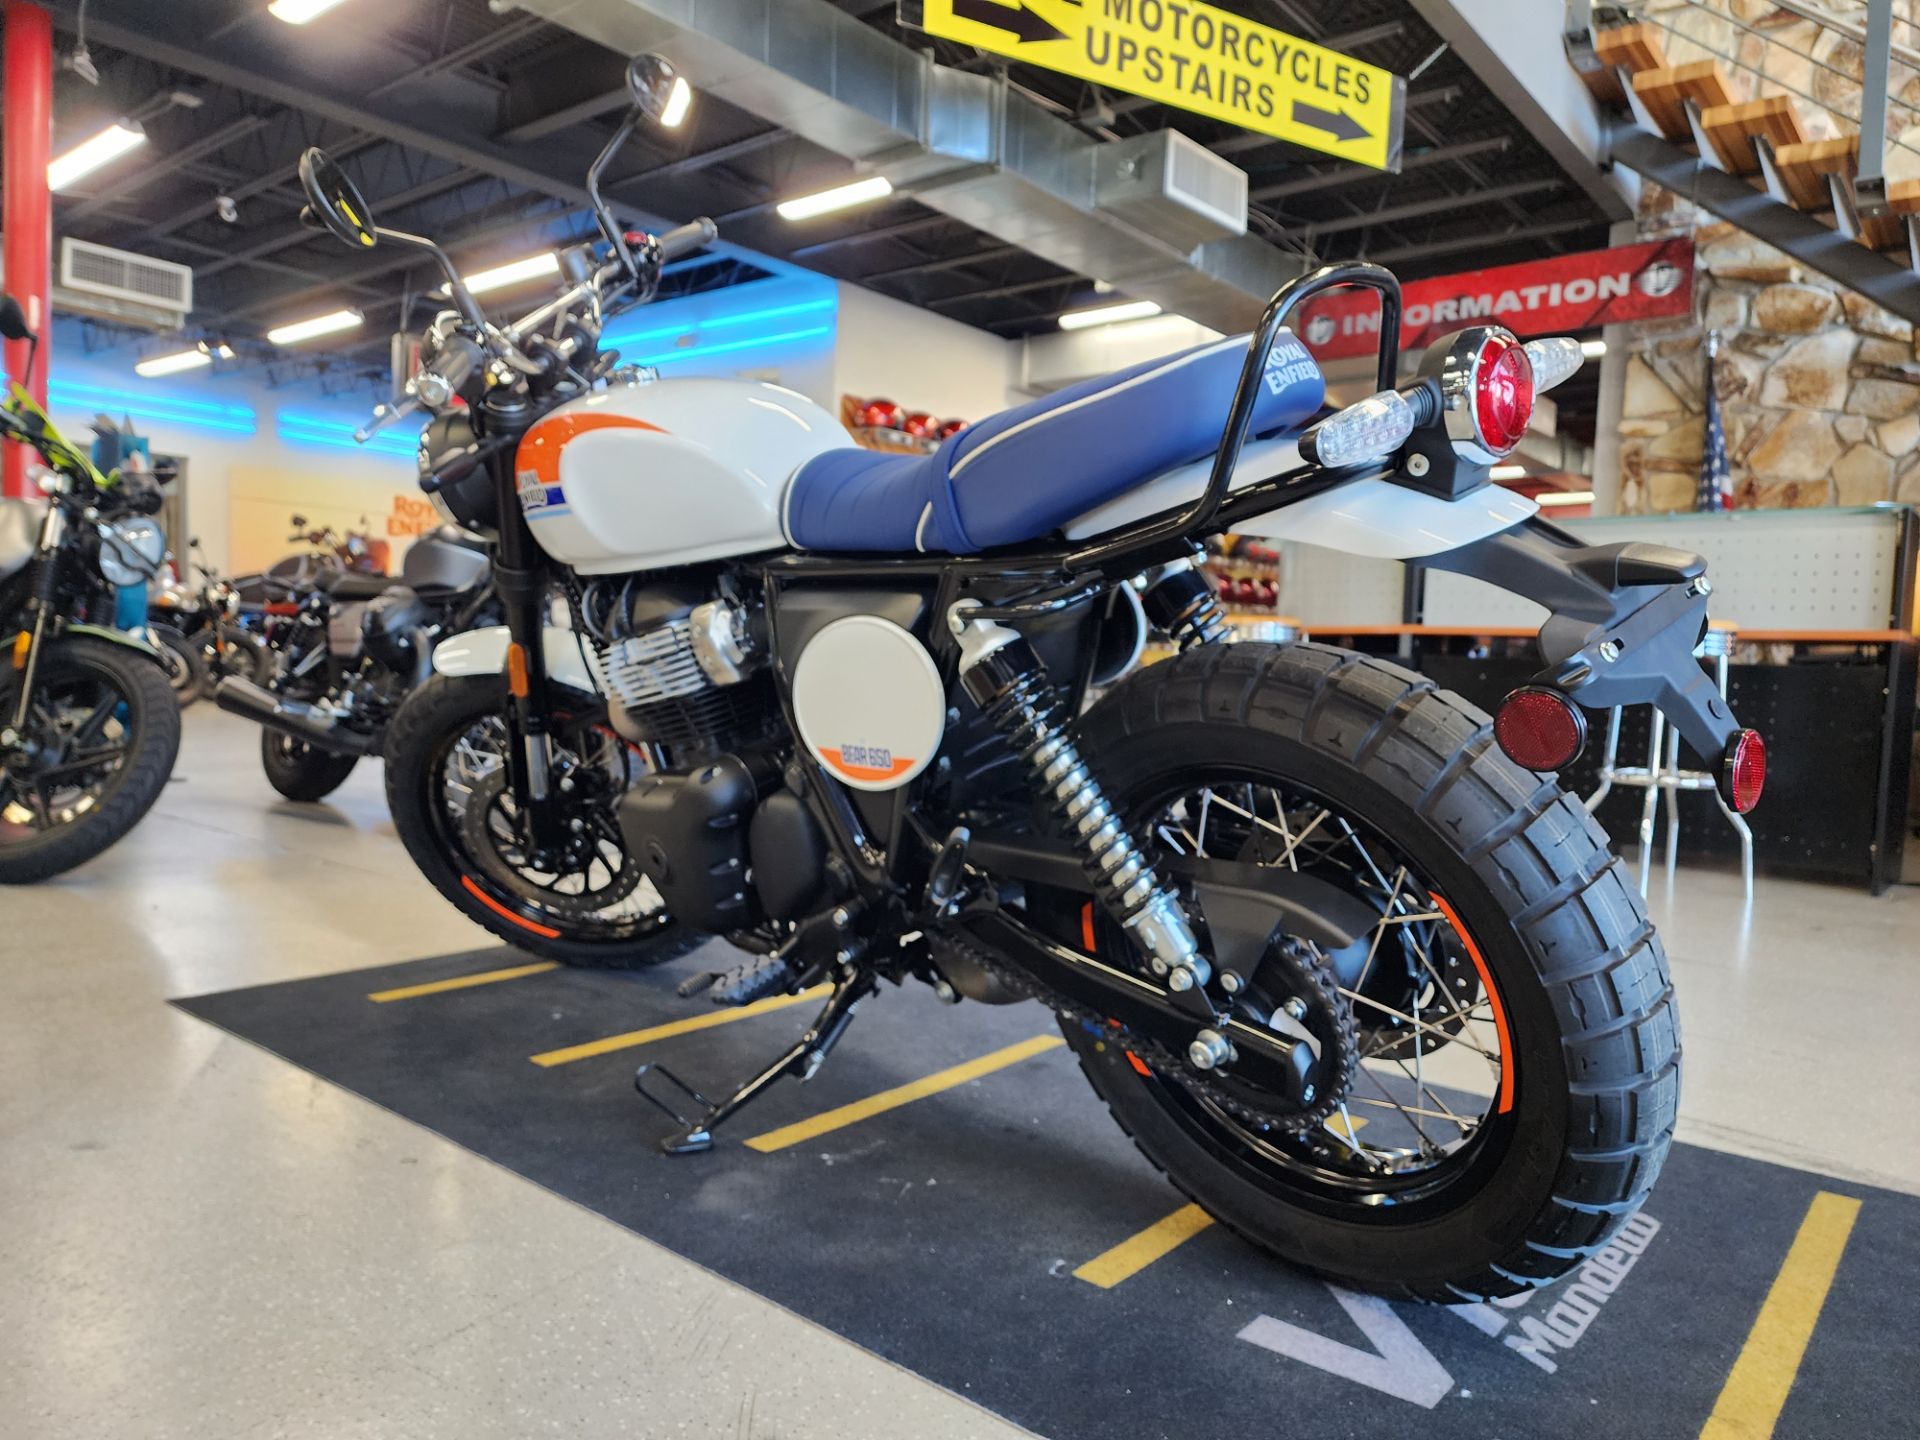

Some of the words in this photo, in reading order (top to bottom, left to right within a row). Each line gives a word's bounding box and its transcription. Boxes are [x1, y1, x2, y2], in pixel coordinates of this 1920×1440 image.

[1085, 26, 1274, 118] UPSTAIRS
[1104, 0, 1370, 104] MOTORCYCLES
[1343, 272, 1631, 336] INORMATION
[841, 744, 866, 765] BEAR
[868, 747, 892, 769] 650
